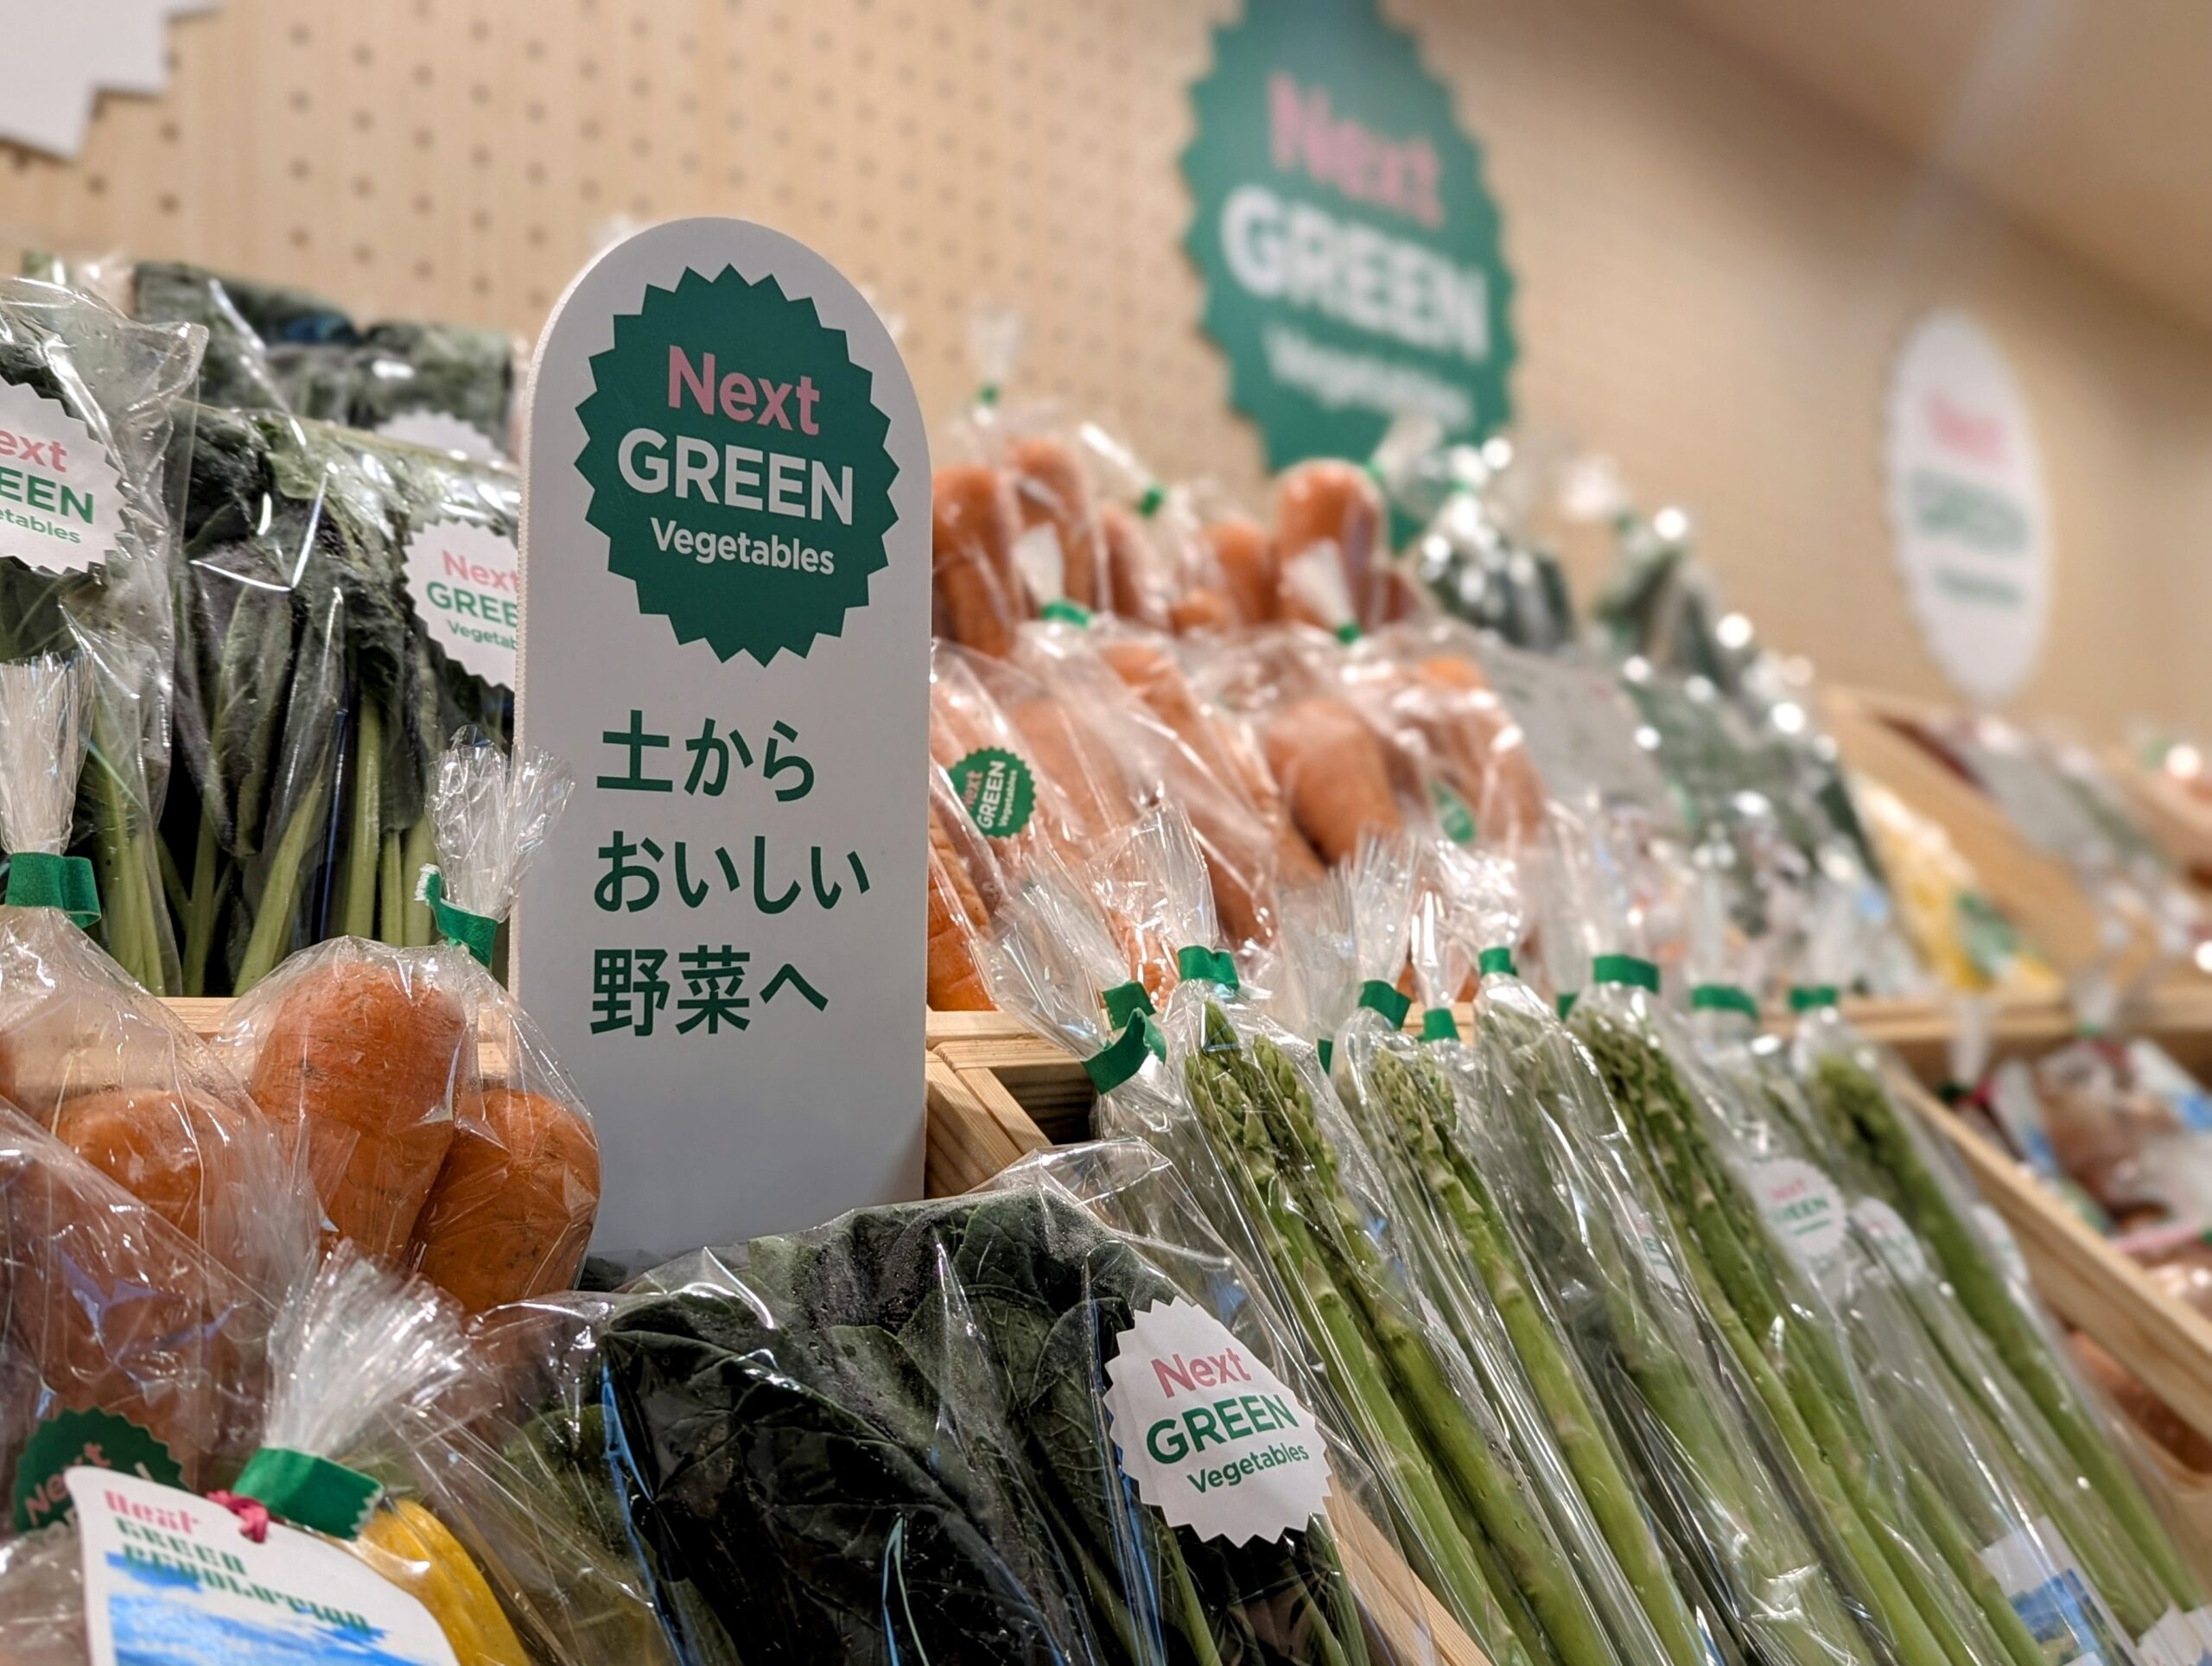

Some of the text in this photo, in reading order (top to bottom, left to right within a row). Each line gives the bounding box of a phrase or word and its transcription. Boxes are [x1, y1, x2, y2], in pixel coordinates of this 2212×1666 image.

[1220, 184, 1489, 361] GREEN
[667, 345, 820, 436] Next
[618, 428, 854, 526] GREEN
[0, 508, 81, 544] tables
[651, 517, 835, 575] Vegetables
[596, 709, 815, 802] 土から
[976, 760, 1007, 829] GREEN
[998, 769, 1018, 826] Vegetables
[594, 830, 870, 914] おいしい
[590, 944, 830, 1036] 野菜へ
[1151, 1348, 1251, 1398] Next
[1147, 1394, 1300, 1464] GREEN
[1186, 1442, 1309, 1493] Vegetables
[25, 1442, 111, 1526] Net
